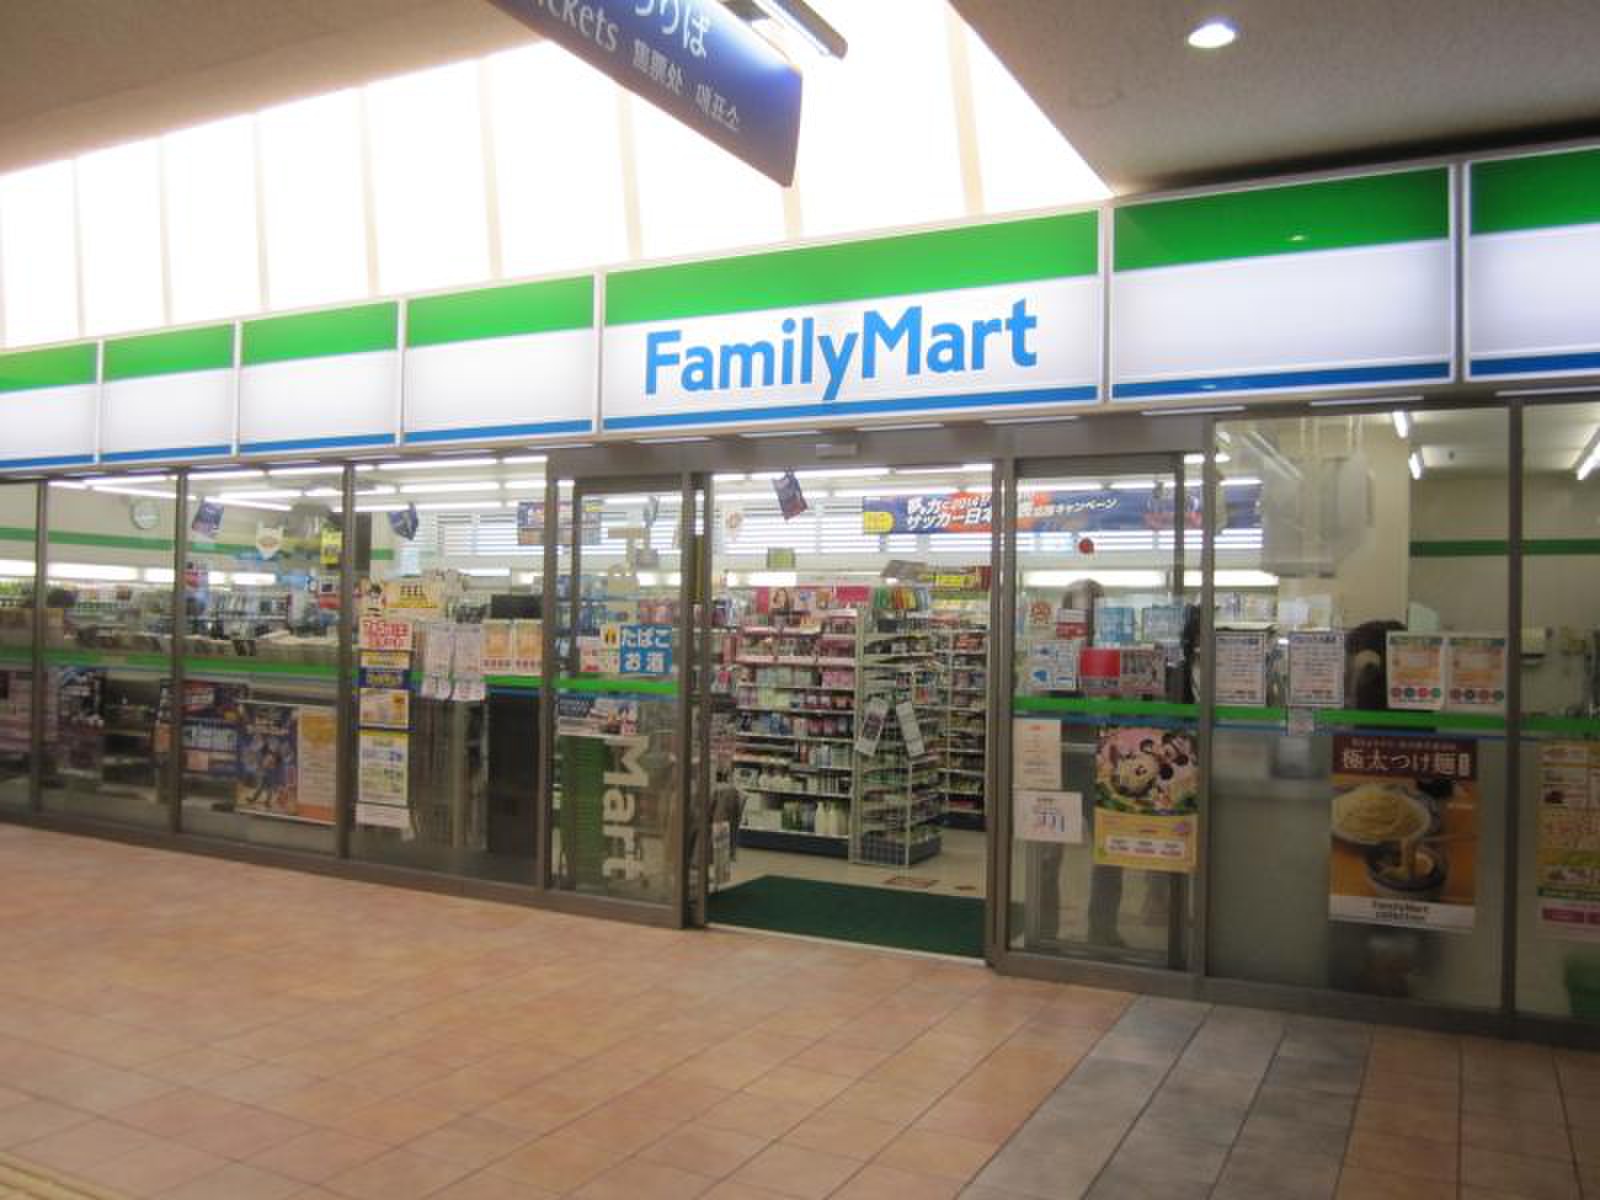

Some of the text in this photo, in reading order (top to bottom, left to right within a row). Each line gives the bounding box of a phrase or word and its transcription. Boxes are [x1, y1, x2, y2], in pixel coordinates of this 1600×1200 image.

[536, 0, 620, 51] ckets
[645, 298, 1038, 401] FamilyMart
[621, 627, 671, 648] たばこ
[602, 736, 650, 881] Mart
